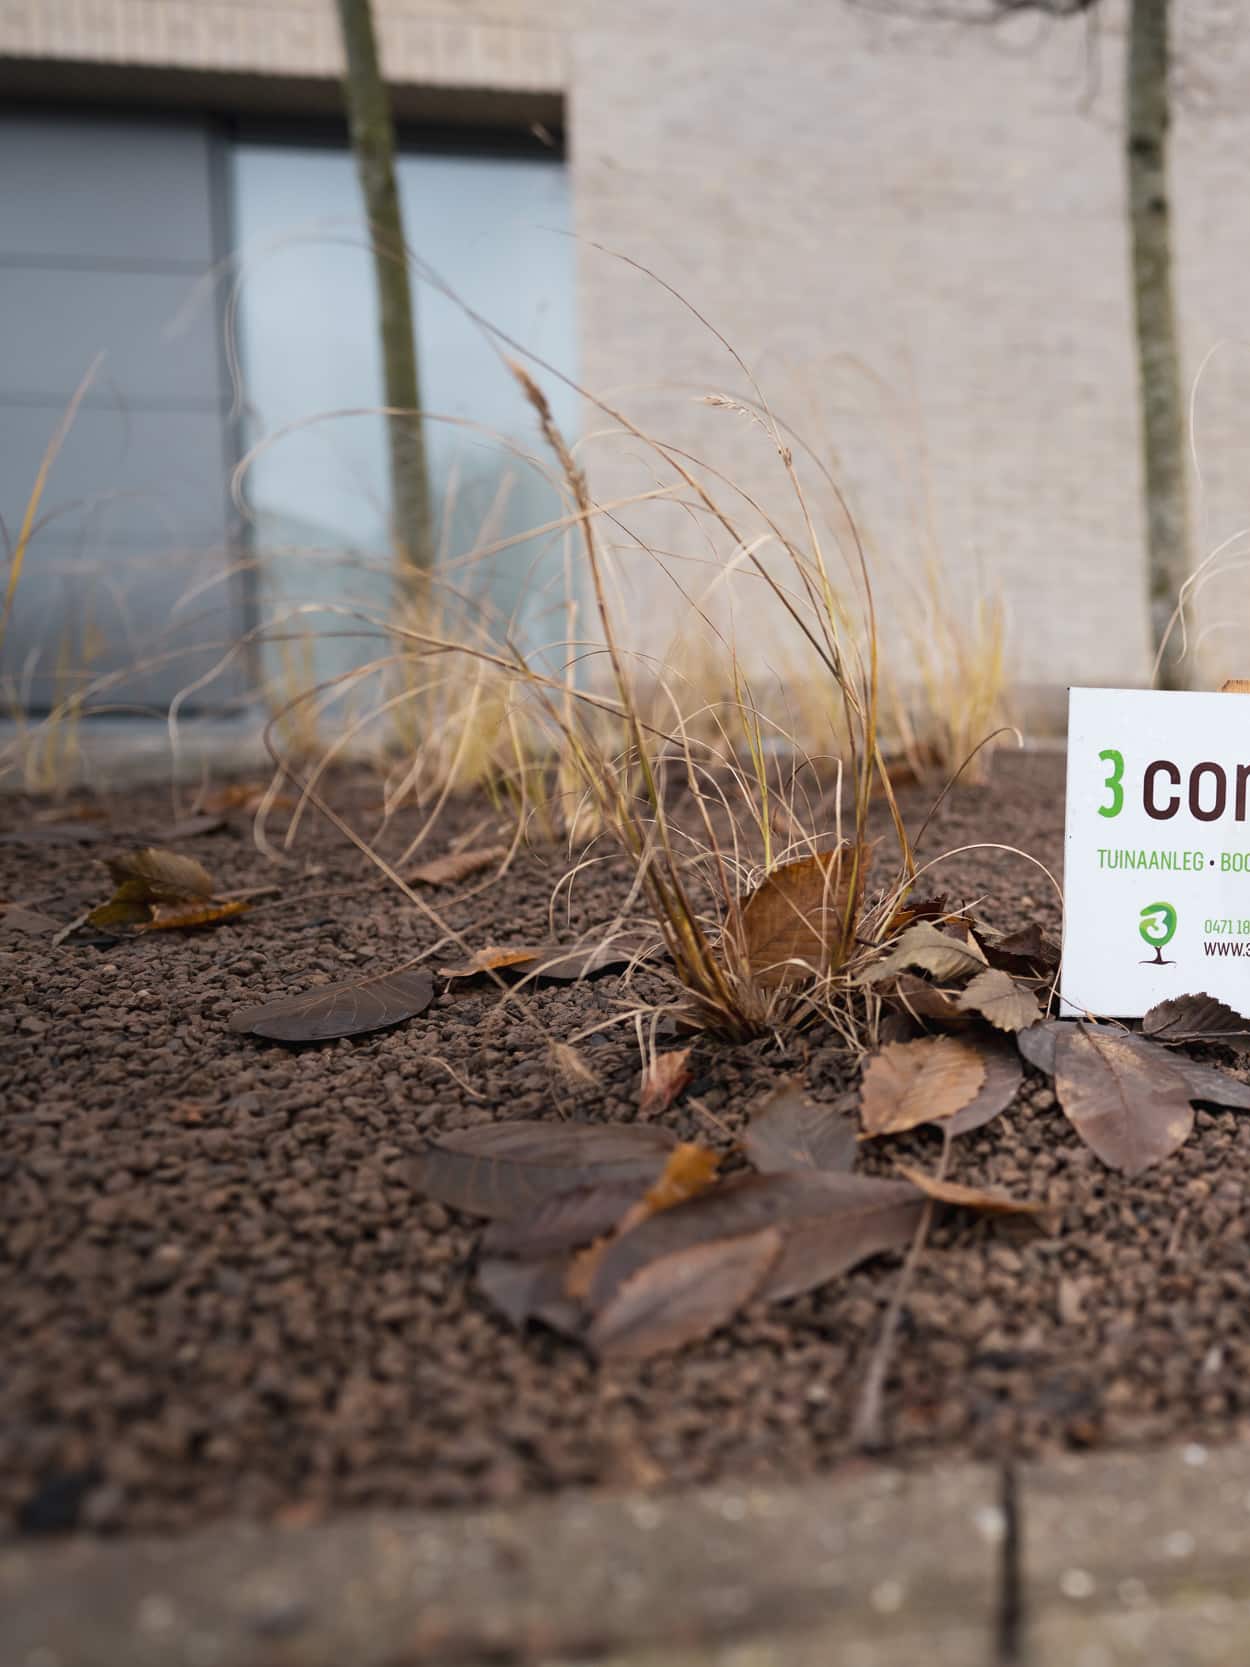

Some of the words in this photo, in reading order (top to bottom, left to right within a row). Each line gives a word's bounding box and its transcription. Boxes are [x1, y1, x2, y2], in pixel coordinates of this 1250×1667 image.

[1097, 749, 1125, 818] 3
[1097, 849, 1204, 872] TUINAANLEG
[1204, 919, 1233, 935] 0471
[1236, 919, 1250, 935] 18
